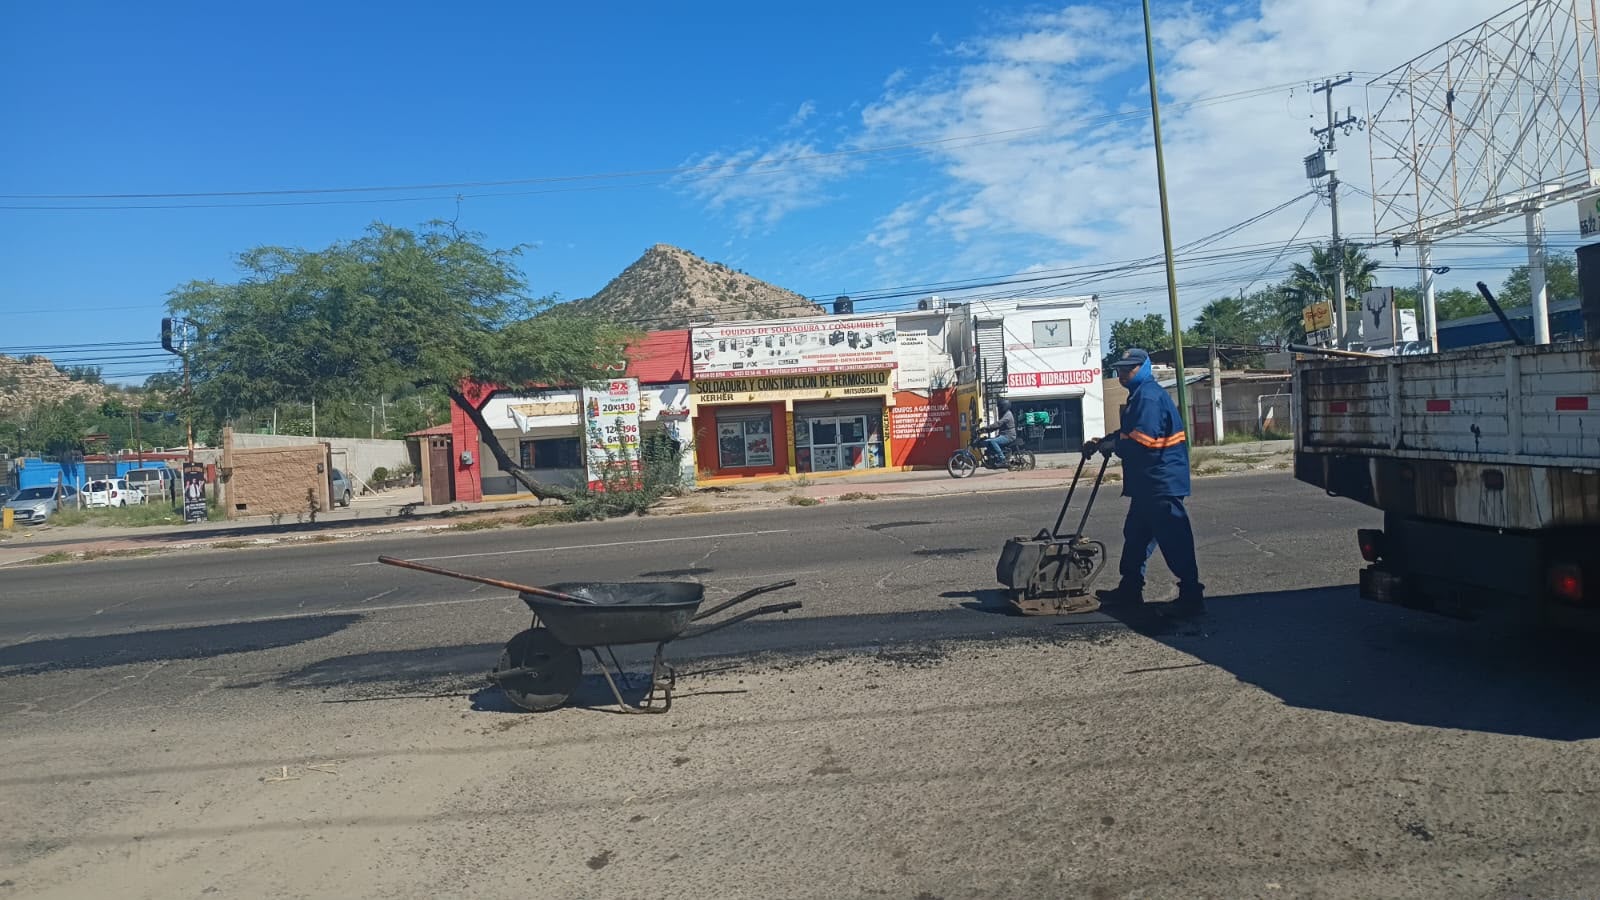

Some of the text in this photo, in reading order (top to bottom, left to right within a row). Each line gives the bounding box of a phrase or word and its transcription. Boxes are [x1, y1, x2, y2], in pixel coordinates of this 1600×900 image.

[720, 328, 756, 337] EQUIPOS
[770, 324, 820, 334] SOLDADURA
[829, 322, 885, 330] CONSUMIBLES
[696, 380, 746, 393] SOLDADURA
[747, 378, 755, 391] Y
[757, 375, 817, 390] CONSTRUCCION
[819, 375, 830, 387] DE
[831, 371, 885, 386] HERMOSILLO
[1010, 373, 1037, 387] SELLOS
[1041, 370, 1092, 385] HIDRAULICOS
[611, 382, 628, 391] SIX
[844, 386, 879, 395] MITSUBISHI
